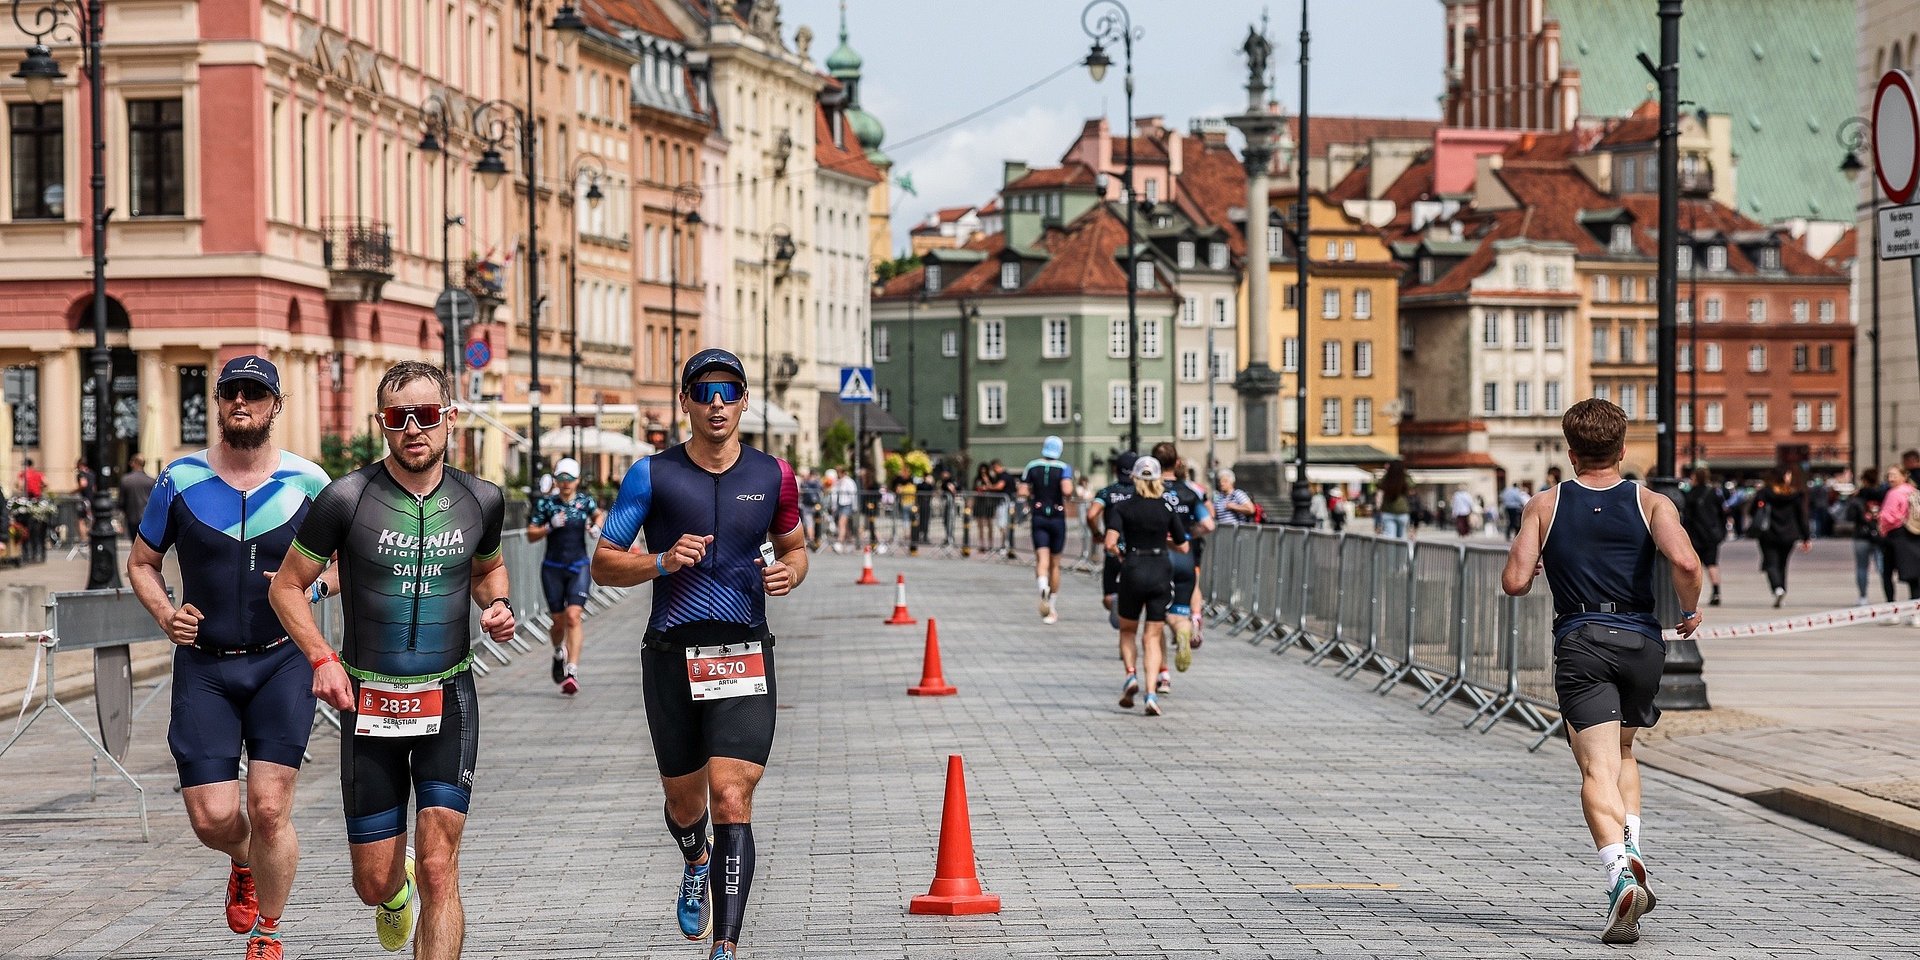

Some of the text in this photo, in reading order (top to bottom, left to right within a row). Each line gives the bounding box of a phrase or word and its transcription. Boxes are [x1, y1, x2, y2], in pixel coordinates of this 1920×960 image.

[393, 563, 444, 577] SAWIK
[401, 581, 432, 594] POL
[707, 661, 746, 676] 2670
[380, 697, 421, 714] 2832
[383, 717, 417, 726] SEBASTIAN
[725, 855, 741, 895] HUUB
